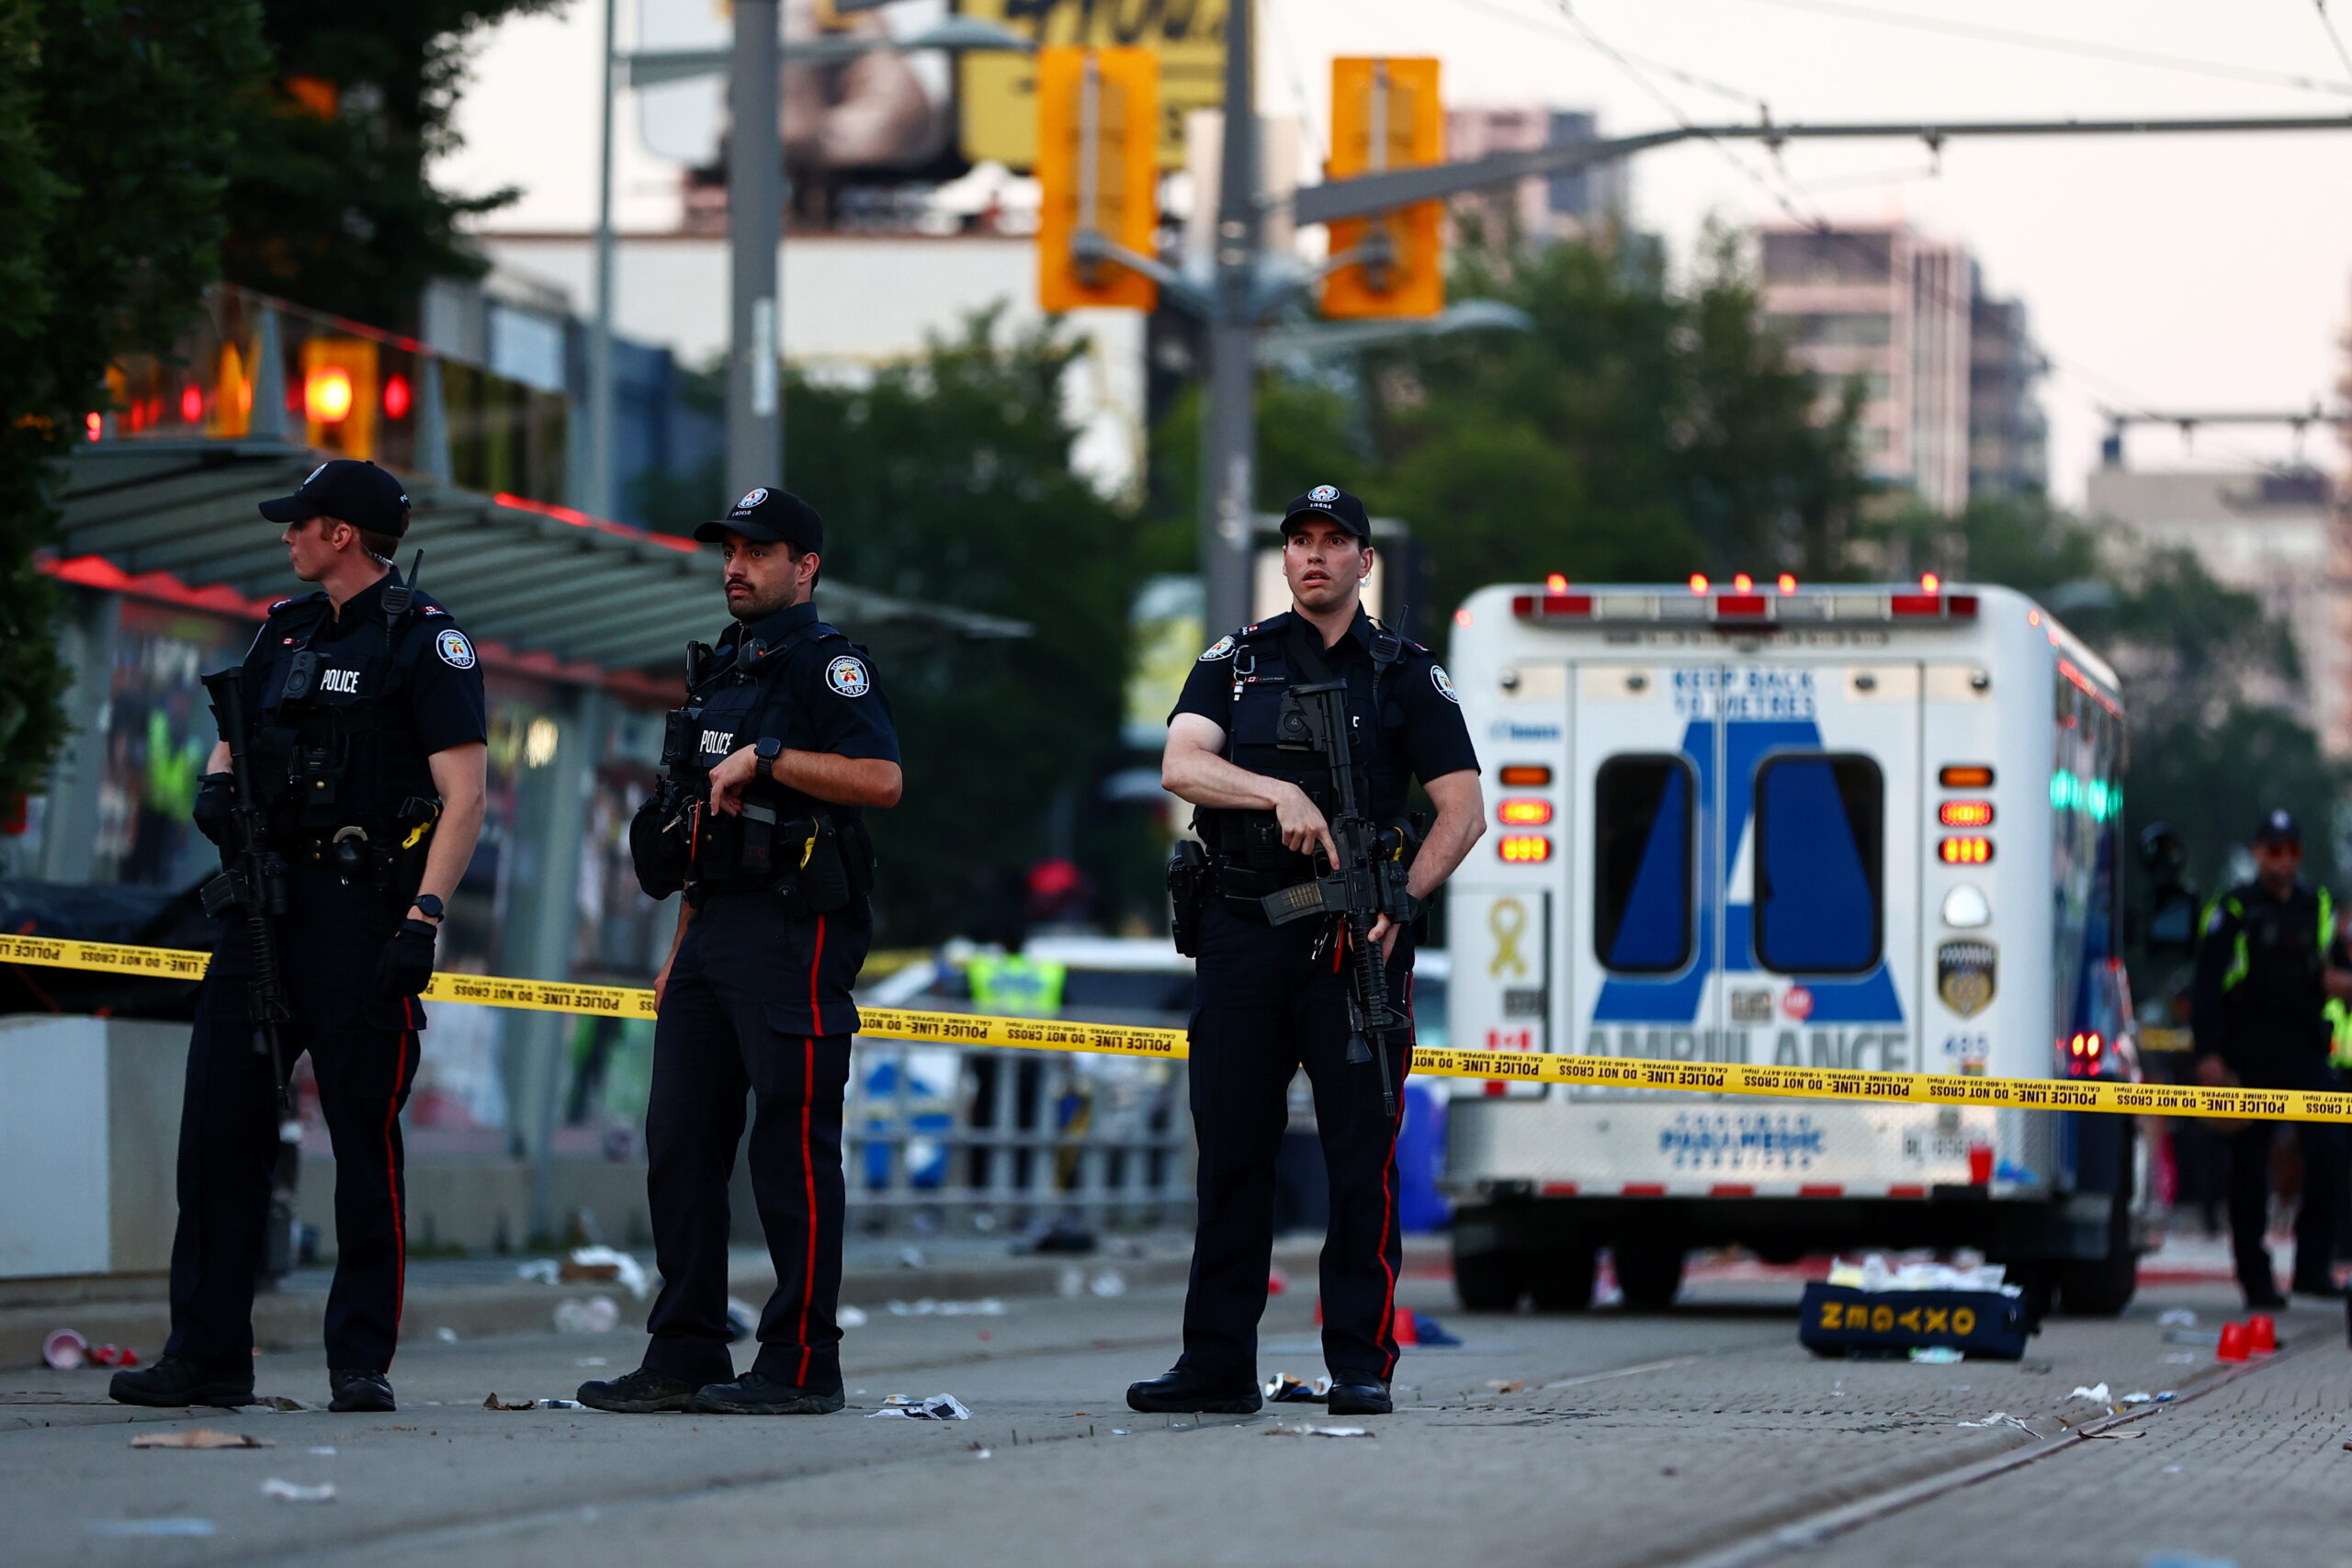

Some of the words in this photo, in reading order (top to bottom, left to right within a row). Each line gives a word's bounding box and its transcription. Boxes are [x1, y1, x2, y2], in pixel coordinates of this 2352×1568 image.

[830, 658, 860, 671] TORONTO
[320, 669, 360, 694] POLICE
[842, 685, 865, 694] POLICE
[699, 729, 734, 755] POLICE
[14, 944, 61, 960] POLICE
[80, 951, 117, 964] CROSS
[119, 954, 141, 966] NOT
[144, 956, 161, 968] DO
[164, 959, 198, 973] LINE-
[454, 985, 490, 998] CROSS
[493, 988, 514, 1000] NOT
[517, 990, 533, 1001] DO
[537, 992, 570, 1006] LINE-
[574, 995, 619, 1010] POLICE
[863, 1018, 883, 1029] NOT
[886, 1020, 901, 1031] DO
[905, 1021, 938, 1034] LINE-
[943, 1023, 988, 1039] POLICE
[1007, 1028, 1043, 1041] CROSS
[1046, 1032, 1067, 1043] NOT
[1069, 1032, 1085, 1043] DO
[1089, 1034, 1122, 1048] LINE-
[1125, 1037, 1171, 1052] POLICE
[1413, 1056, 1434, 1066] NOT
[1438, 1058, 1453, 1068] DO
[1457, 1059, 1490, 1072] LINE-
[1494, 1061, 1539, 1075] POLICE
[1558, 1065, 1594, 1077] CROSS
[1597, 1067, 1619, 1078] NOT
[1622, 1068, 1637, 1079] DO
[1641, 1069, 1674, 1083] LINE-
[1679, 1072, 1724, 1087] POLICE
[1744, 1075, 1779, 1088] CROSS
[1782, 1077, 1804, 1089] NOT
[1807, 1078, 1823, 1089] DO
[1826, 1079, 1860, 1094] LINE-
[1864, 1082, 1909, 1096] POLICE
[1929, 1085, 1965, 1097] CROSS
[1968, 1087, 1990, 1099] NOT
[1994, 1089, 2008, 1100] DO
[2013, 1089, 2046, 1103] LINE-
[2051, 1091, 2097, 1105] POLICE
[2116, 1094, 2153, 1106] CROSS
[2155, 1096, 2177, 1107] NOT
[2181, 1097, 2197, 1108] DO
[2200, 1098, 2234, 1111] LINE-
[2239, 1100, 2285, 1113] POLICE
[2305, 1102, 2342, 1114] CROSS
[1819, 1302, 1975, 1336] OXYGEN
